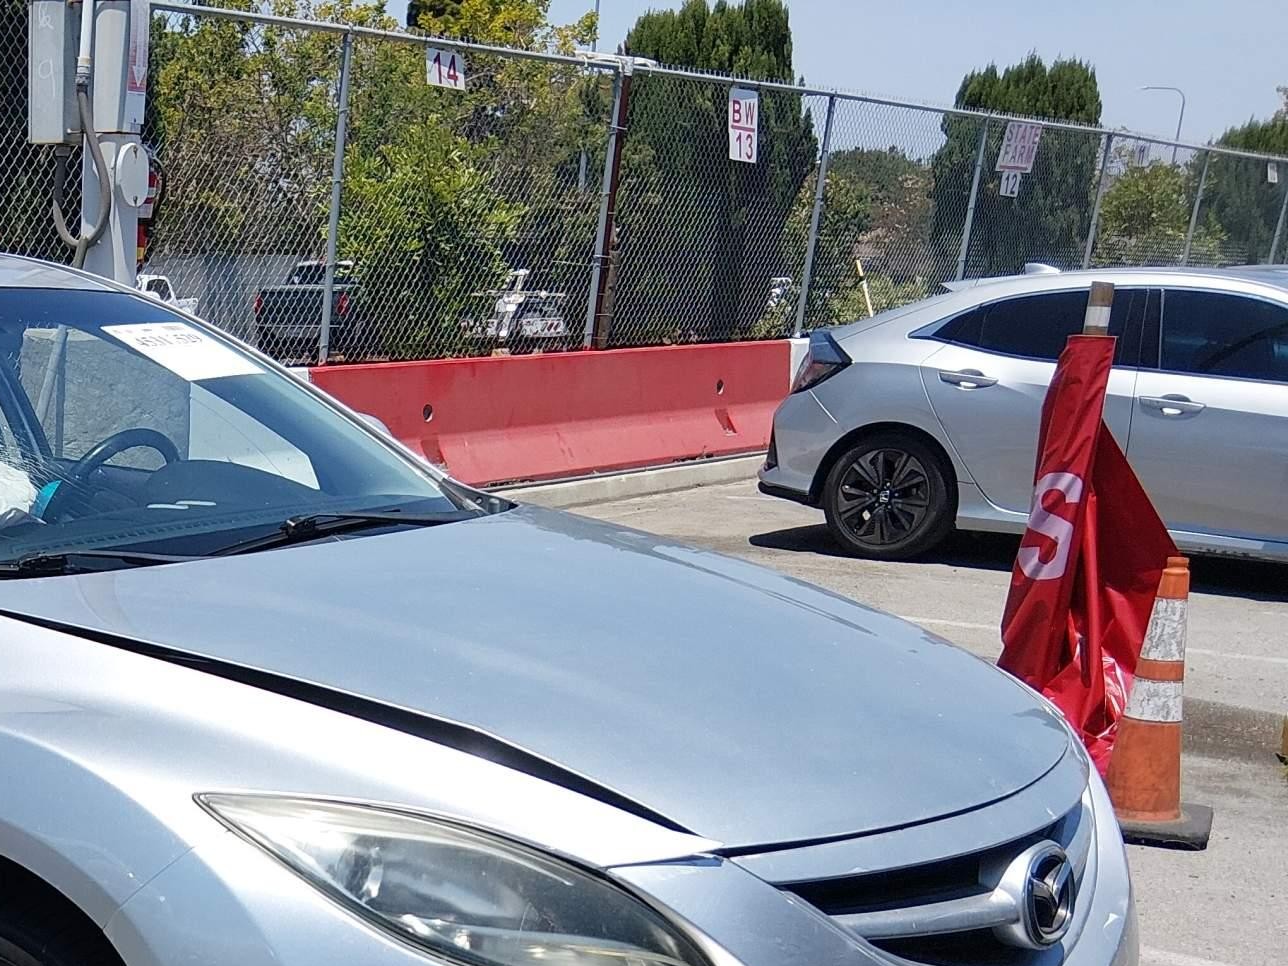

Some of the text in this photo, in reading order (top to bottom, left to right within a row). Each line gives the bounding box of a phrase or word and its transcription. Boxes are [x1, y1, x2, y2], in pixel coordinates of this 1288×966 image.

[433, 51, 459, 87] 14
[732, 99, 755, 126] BW
[735, 131, 754, 160] 13
[1006, 123, 1041, 145] STATE
[1002, 143, 1035, 164] FARM
[1005, 173, 1018, 195] 12
